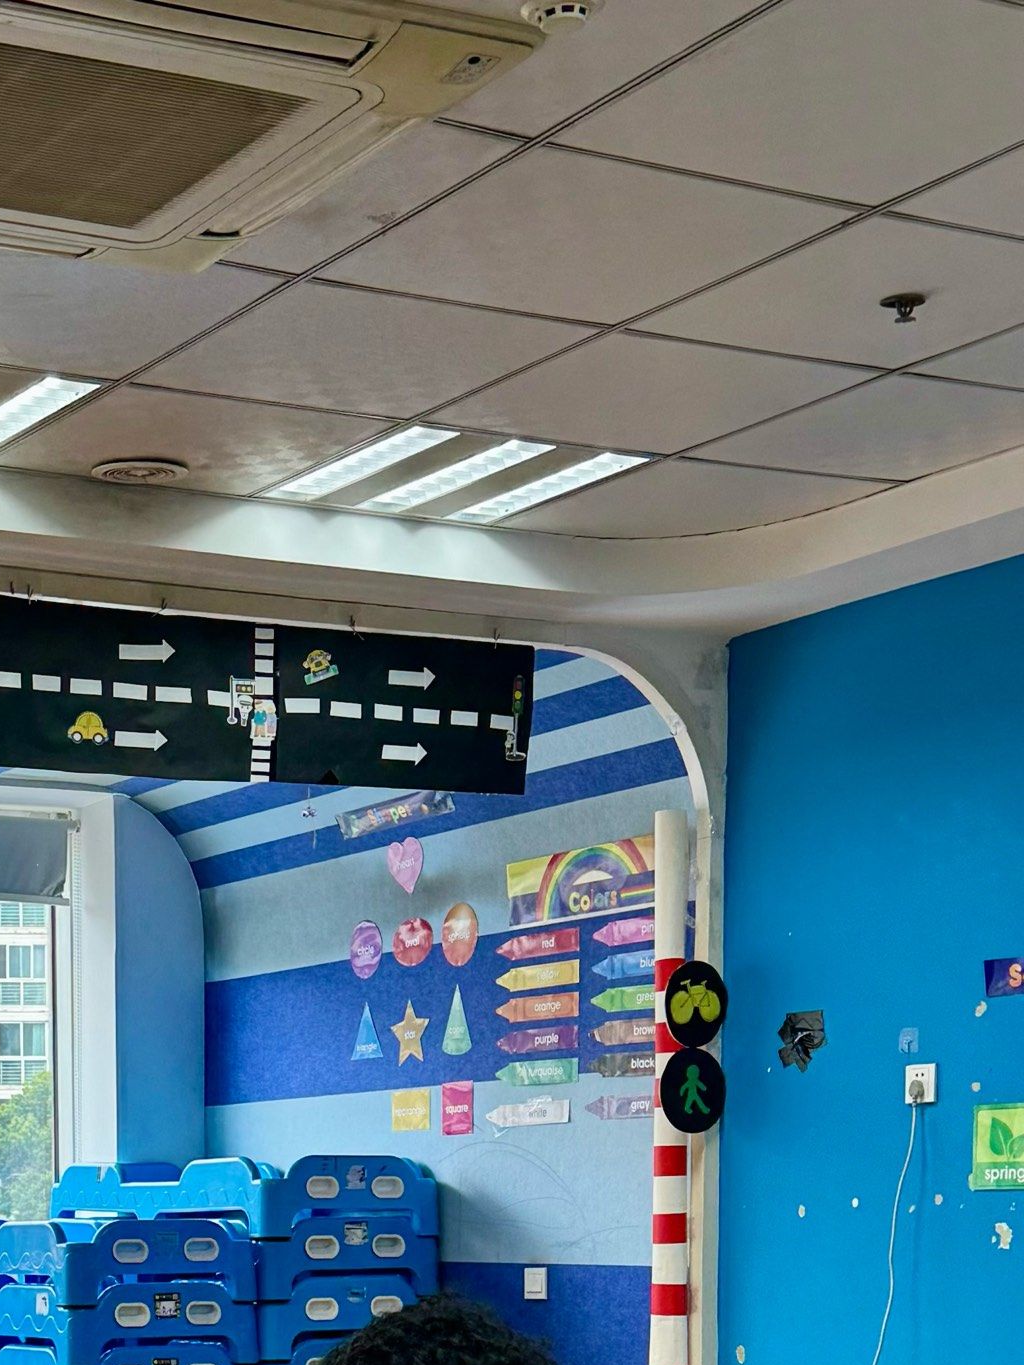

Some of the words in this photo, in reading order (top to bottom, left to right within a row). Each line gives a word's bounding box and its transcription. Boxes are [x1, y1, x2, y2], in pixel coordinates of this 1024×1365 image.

[568, 888, 618, 913] Colors
[641, 923, 655, 936] pin
[541, 937, 555, 949] red
[1008, 963, 1024, 988] S
[636, 992, 655, 1004] gree
[534, 1001, 561, 1013] orange
[534, 1033, 559, 1047] purple
[631, 1058, 655, 1069] black
[445, 1104, 469, 1115] square
[631, 1100, 650, 1112] gray
